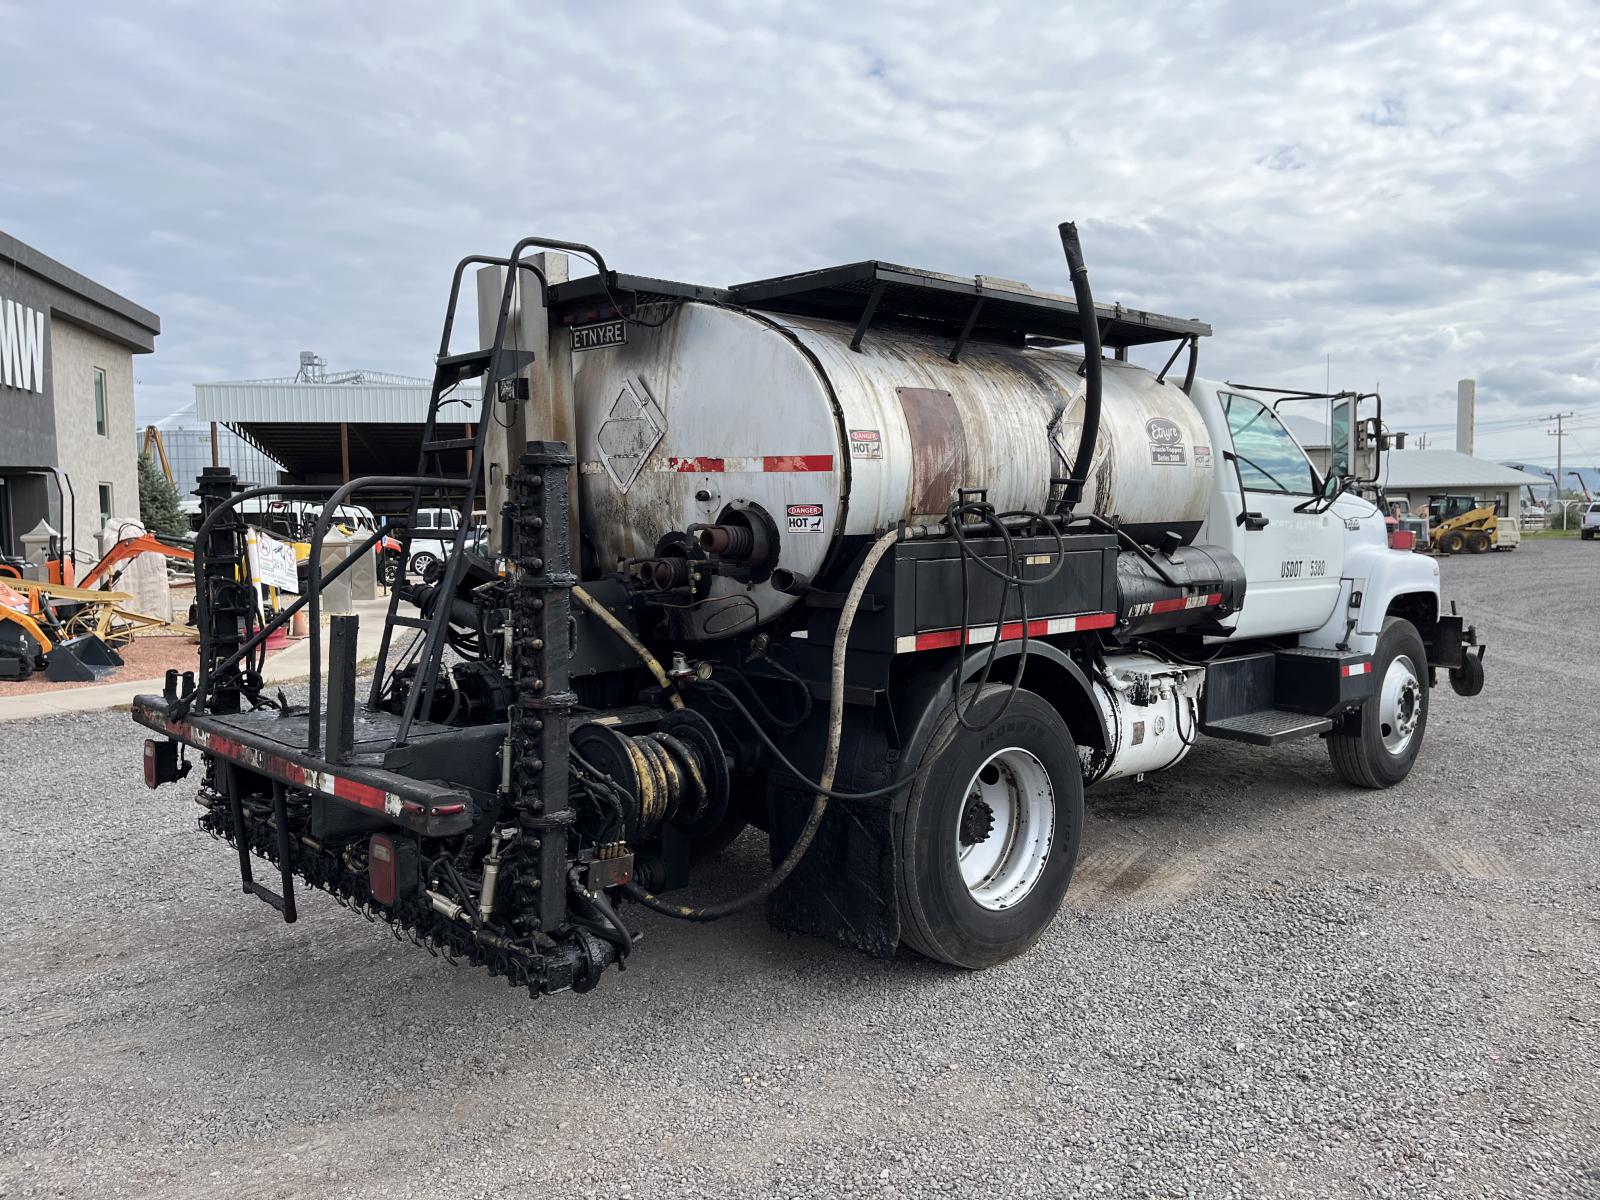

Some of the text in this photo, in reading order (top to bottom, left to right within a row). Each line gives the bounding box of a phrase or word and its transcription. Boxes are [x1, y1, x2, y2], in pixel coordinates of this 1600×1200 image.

[574, 324, 622, 348] ETNYRE
[1151, 423, 1178, 441] Etnyre
[853, 443, 870, 453] HOT
[791, 507, 818, 515] DANGER
[789, 518, 808, 528] HOT
[1281, 560, 1303, 578] USDOT
